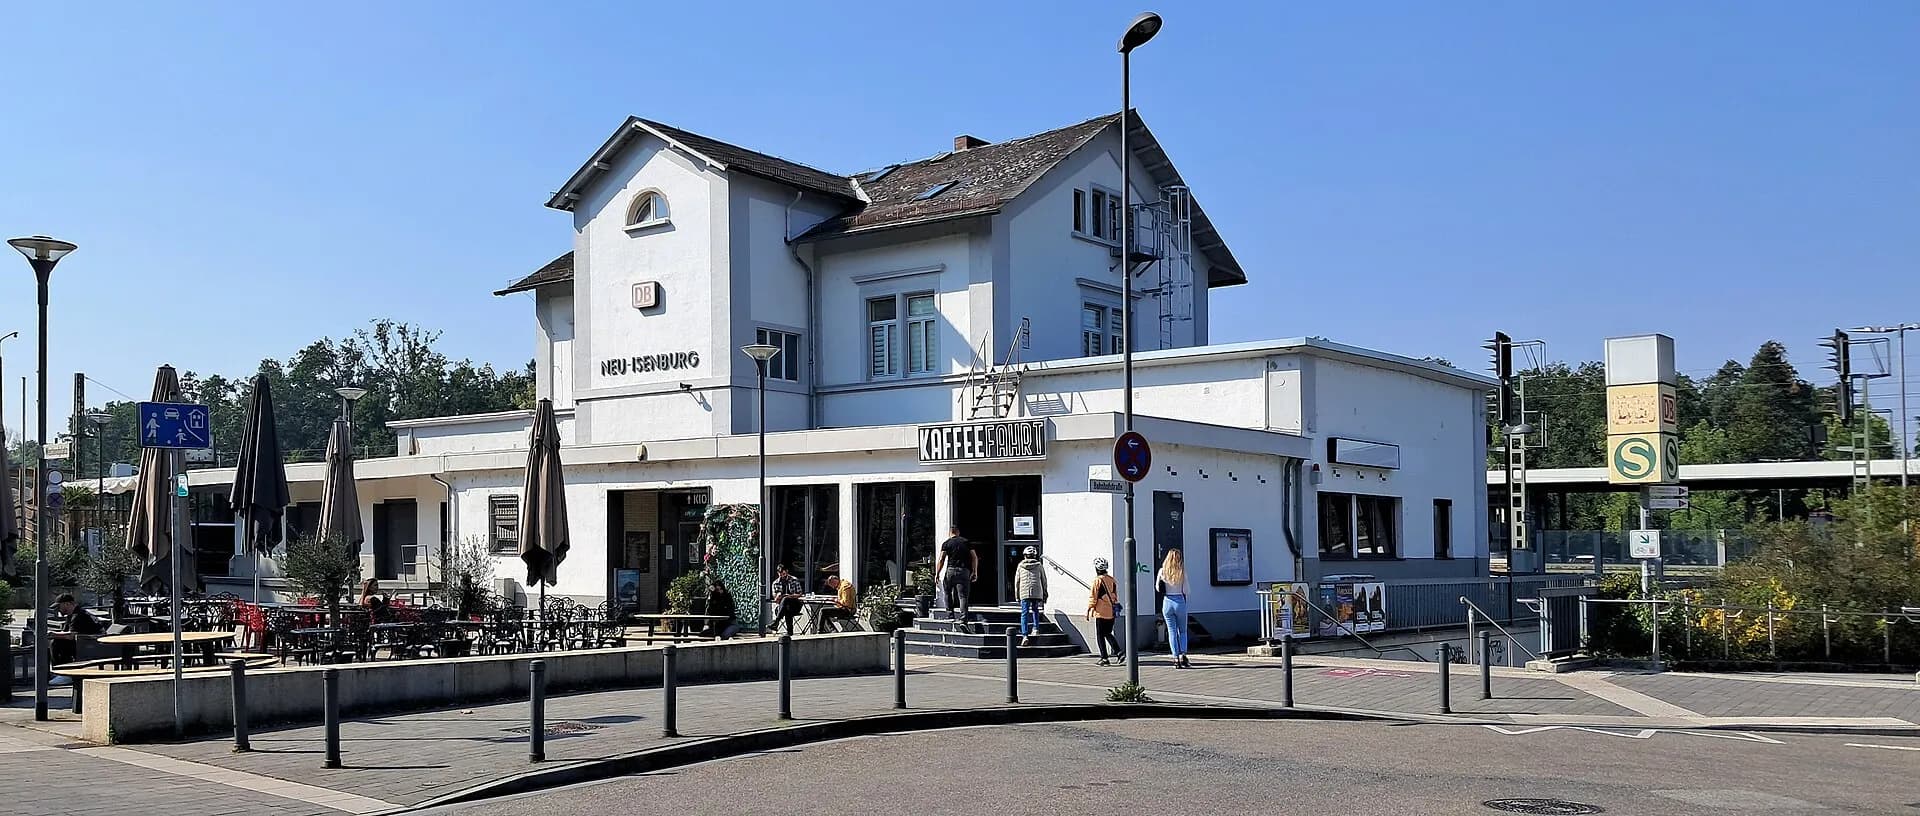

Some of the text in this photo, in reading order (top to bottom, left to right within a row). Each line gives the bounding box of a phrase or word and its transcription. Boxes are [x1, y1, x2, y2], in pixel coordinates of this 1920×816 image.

[634, 286, 652, 305] DB
[601, 350, 700, 376] NEU-ISENBURG
[1663, 398, 1675, 420] DB
[919, 421, 1044, 461] KAFFEEFAHRT
[1619, 440, 1651, 476] S
